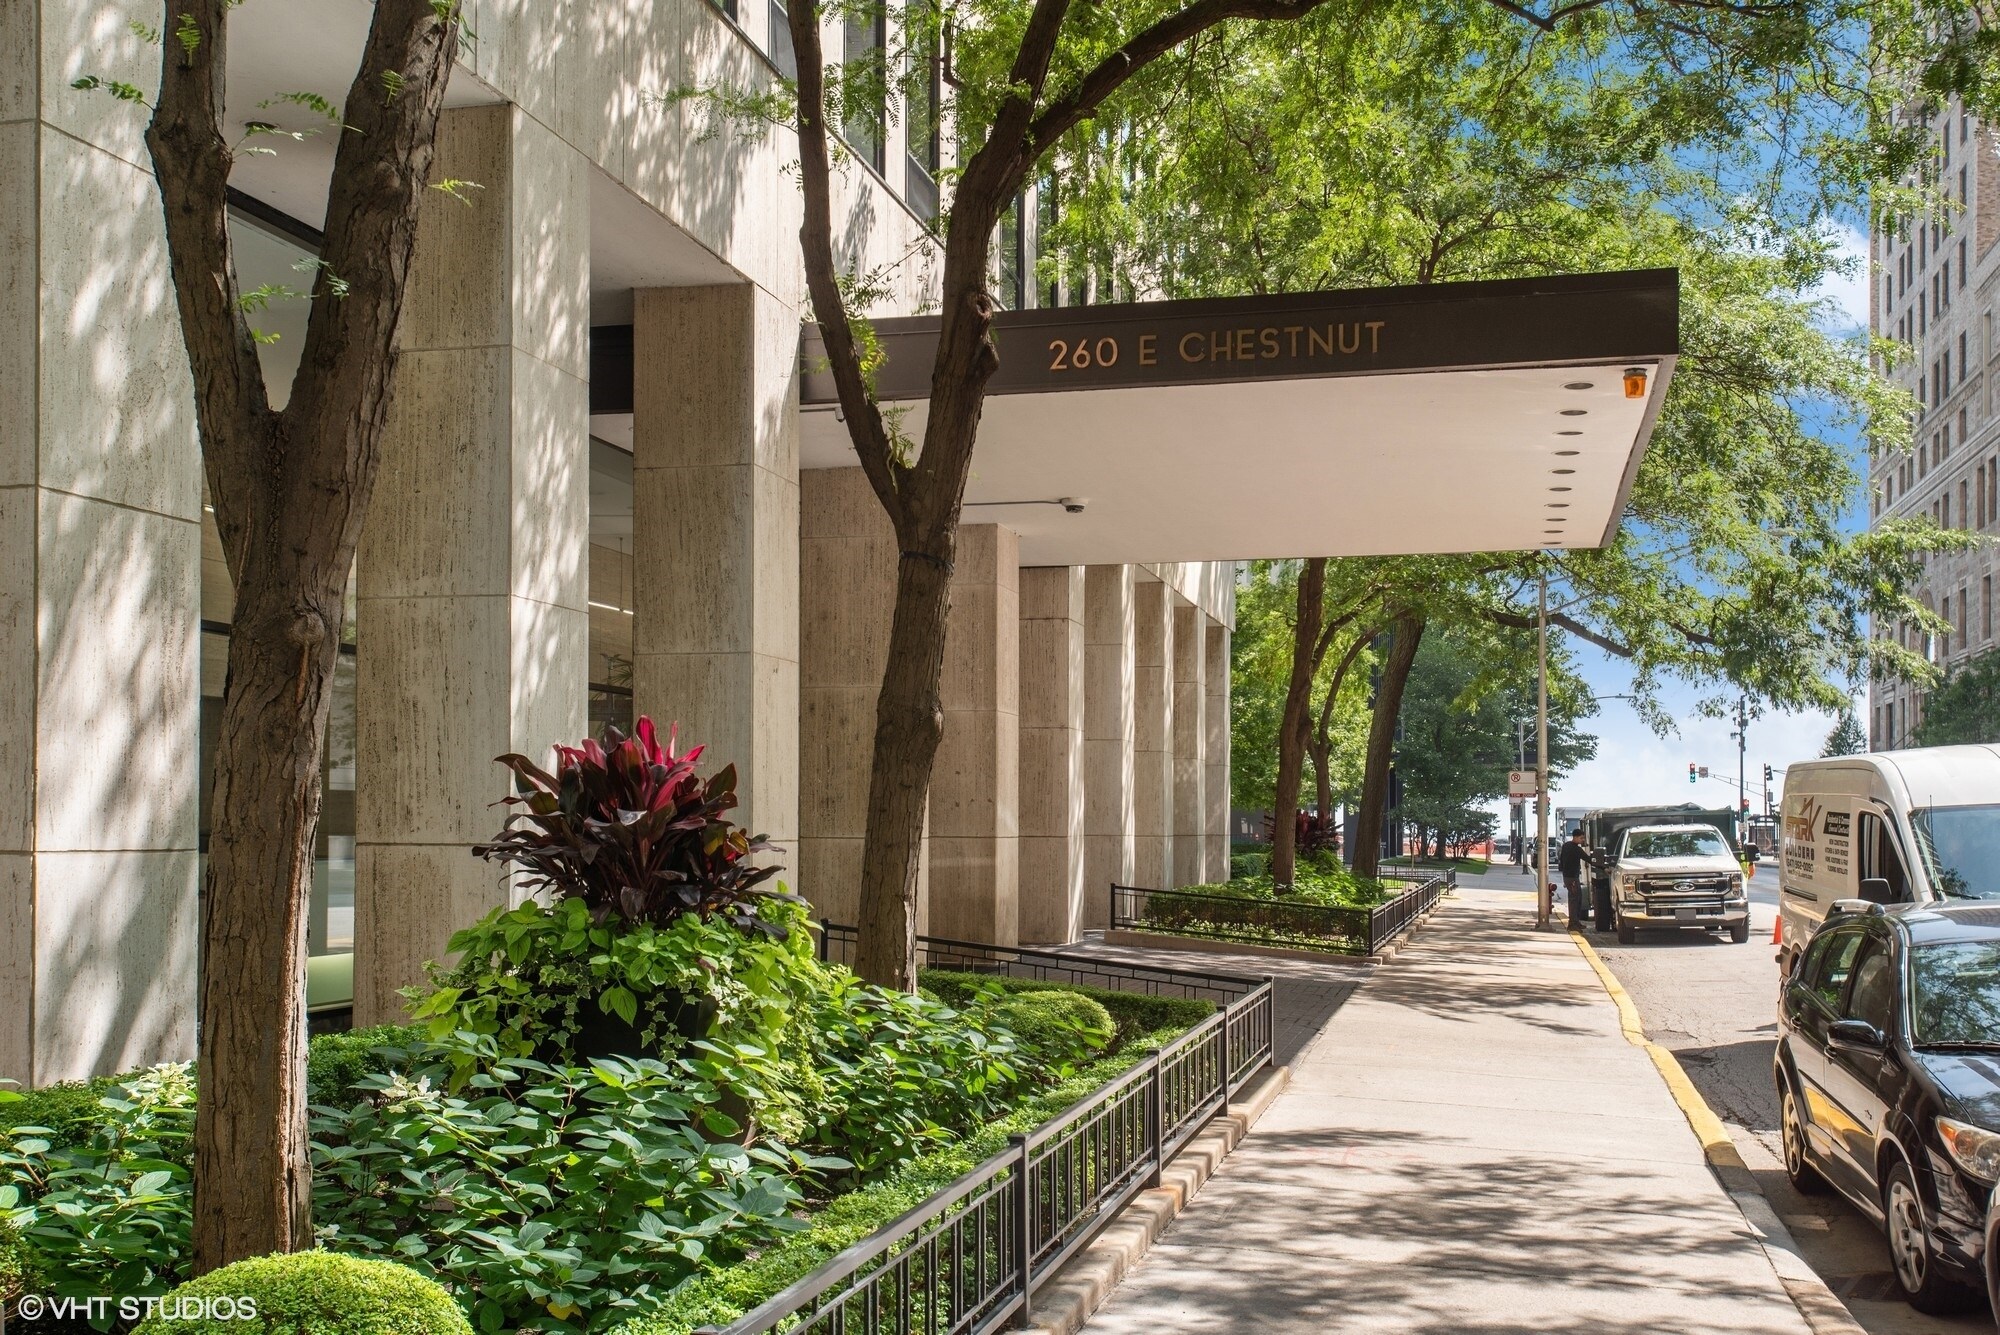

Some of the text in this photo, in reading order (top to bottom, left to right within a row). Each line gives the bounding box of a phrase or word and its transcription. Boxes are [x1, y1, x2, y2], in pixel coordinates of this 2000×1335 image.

[1049, 321, 1385, 370] 260 E CHESTNUT
[1785, 799, 1822, 842] STARK
